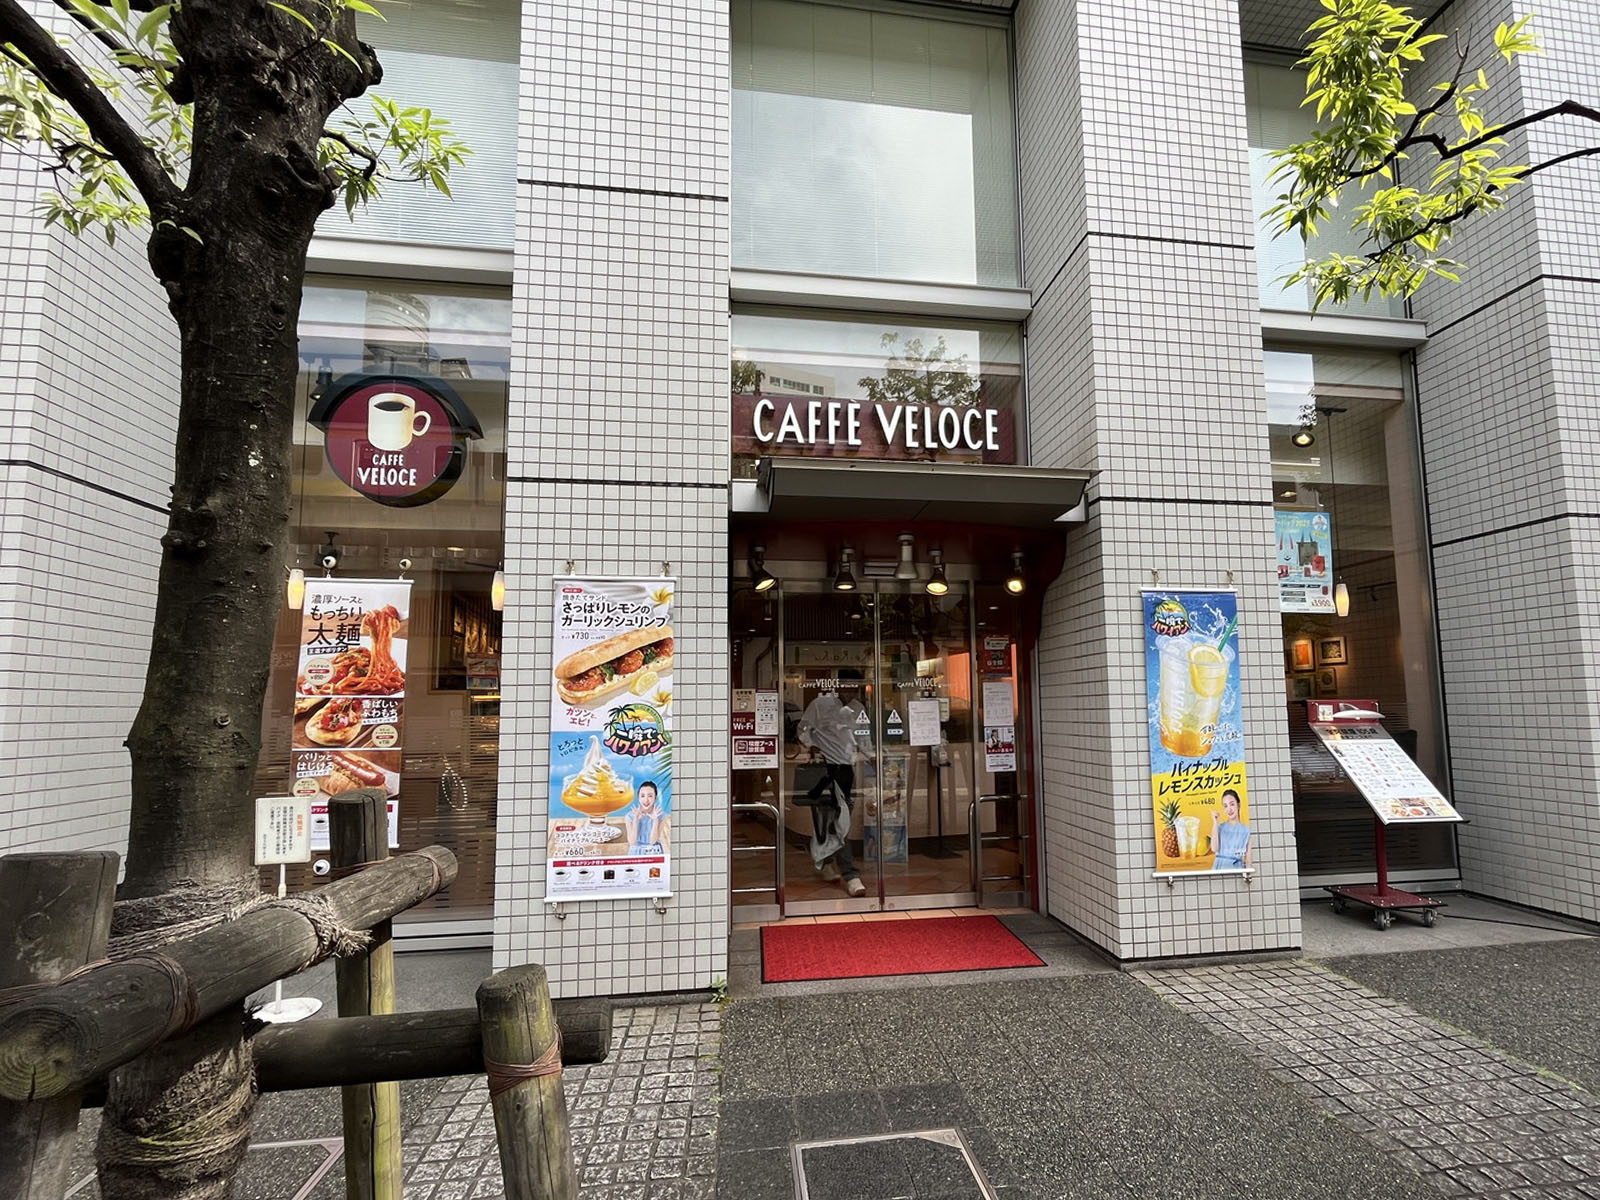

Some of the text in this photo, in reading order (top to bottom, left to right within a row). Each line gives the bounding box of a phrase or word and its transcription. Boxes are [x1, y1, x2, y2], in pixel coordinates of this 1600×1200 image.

[874, 404, 1000, 450] VELOCE
[357, 467, 417, 486] VELOCE
[311, 594, 363, 604] 濃厚ソースと
[310, 606, 363, 622] もっちり
[563, 602, 651, 614] さっぱりレモンの
[561, 614, 668, 628] ガーリックシュリンプ
[307, 623, 361, 646] 太麺
[815, 678, 840, 688] VELOCE
[914, 678, 937, 688] VELOCE
[733, 723, 754, 731] Wi-Fi
[1170, 757, 1229, 777] パイナップル
[1159, 772, 1242, 796] レモンスカッシュ
[565, 848, 584, 856] ¥660
